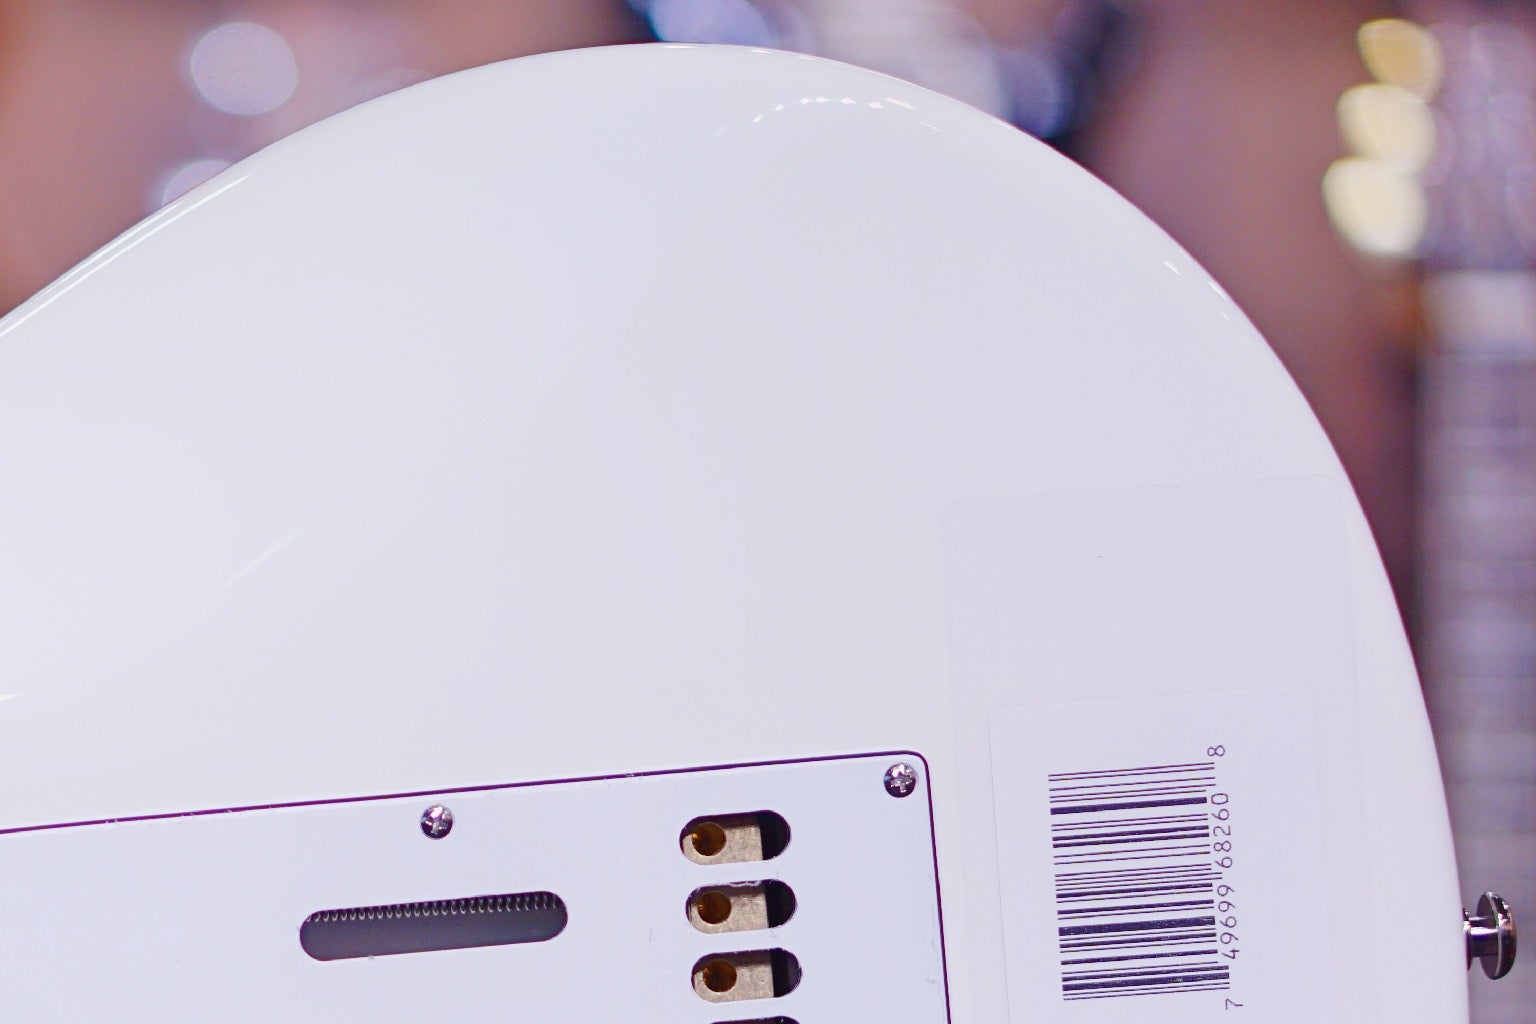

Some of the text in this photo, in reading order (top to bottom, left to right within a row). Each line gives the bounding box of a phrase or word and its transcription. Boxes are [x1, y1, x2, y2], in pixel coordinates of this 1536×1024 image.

[1206, 744, 1244, 1011] 7 49699 68260 8
